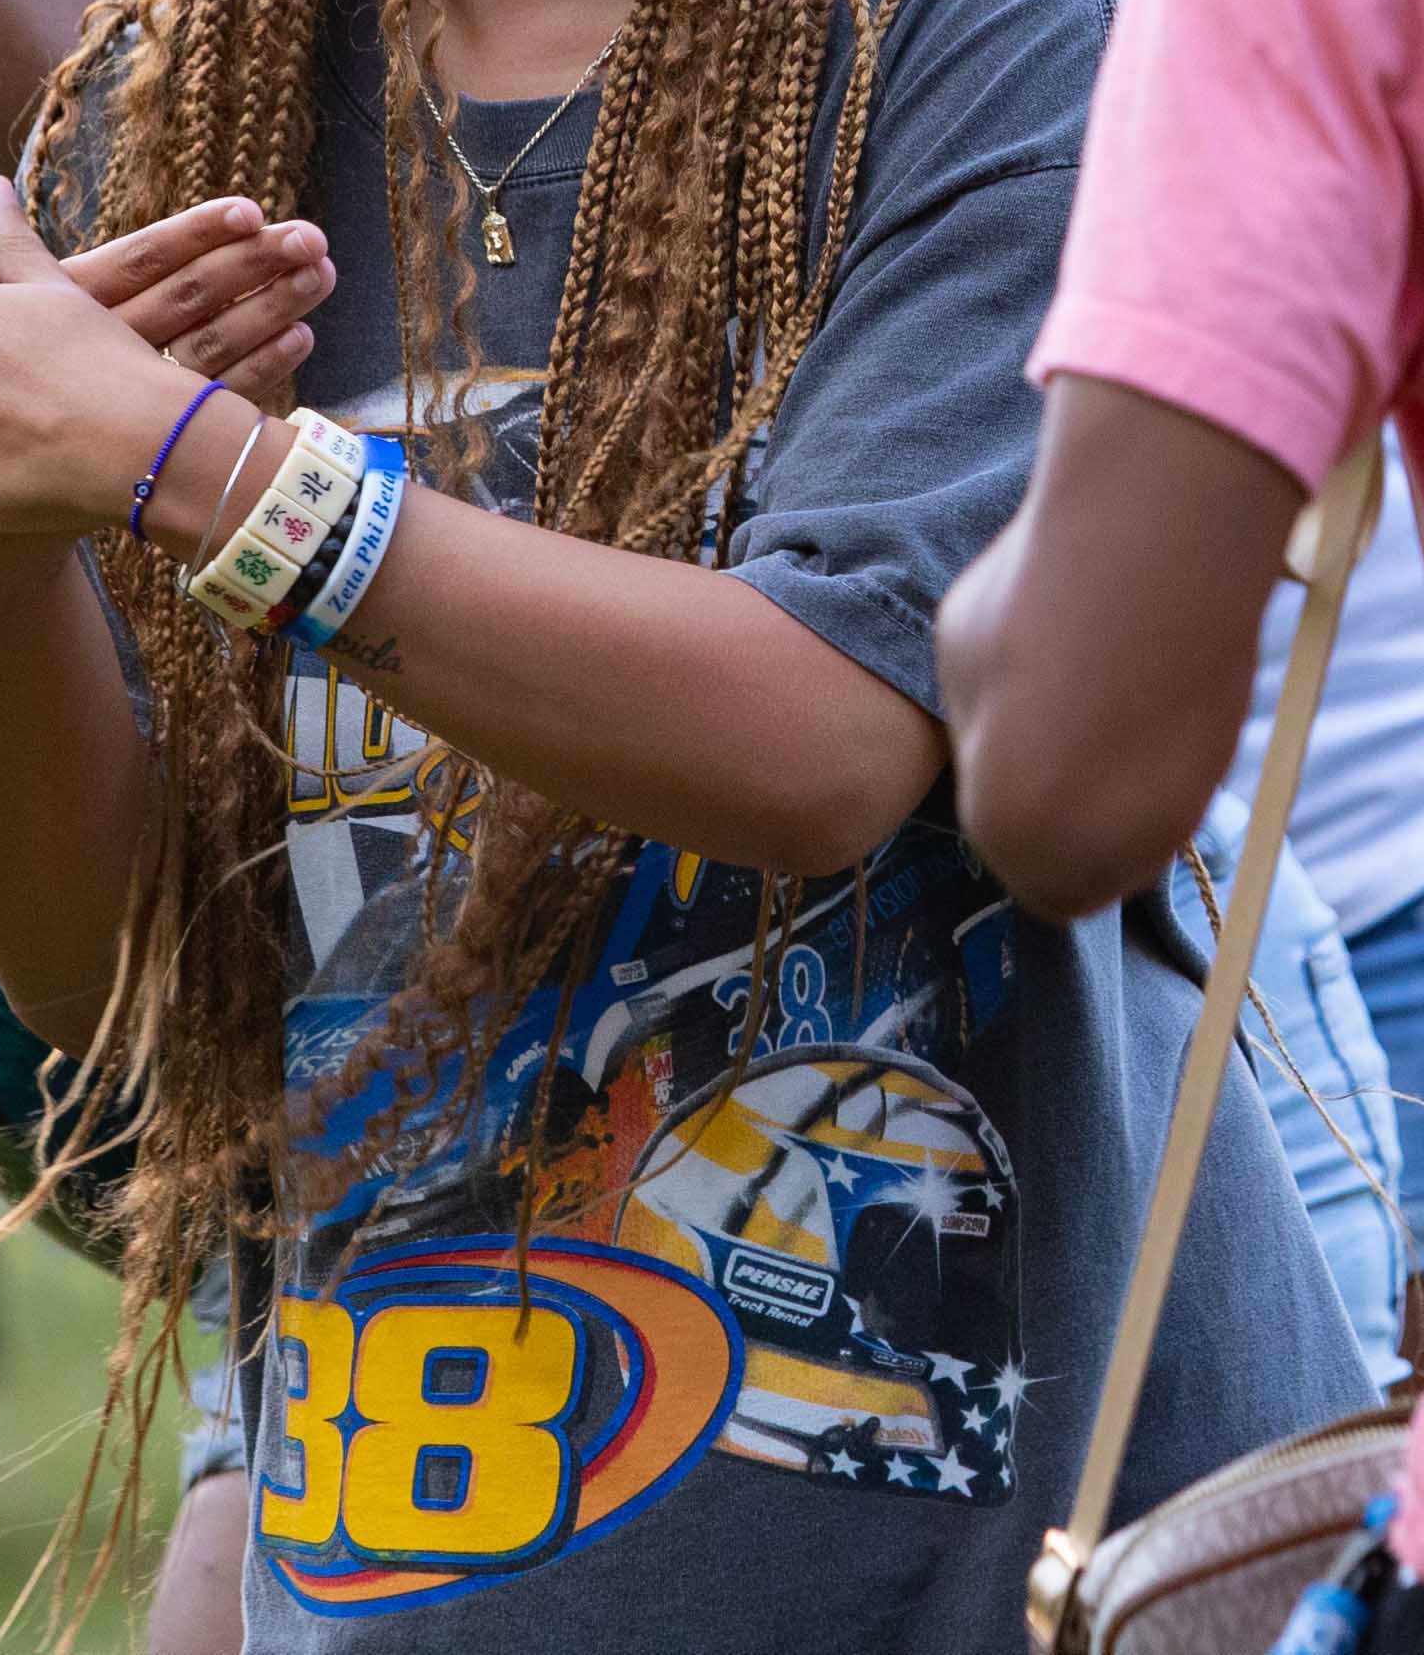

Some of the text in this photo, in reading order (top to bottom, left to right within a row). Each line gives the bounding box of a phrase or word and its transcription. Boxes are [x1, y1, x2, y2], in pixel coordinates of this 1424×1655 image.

[299, 470, 333, 504] 北
[326, 470, 398, 615] Zeta Phi Beta
[734, 1263, 824, 1303] PENSKE
[727, 1292, 815, 1329] Truck Rental
[255, 1288, 588, 1563] 38
